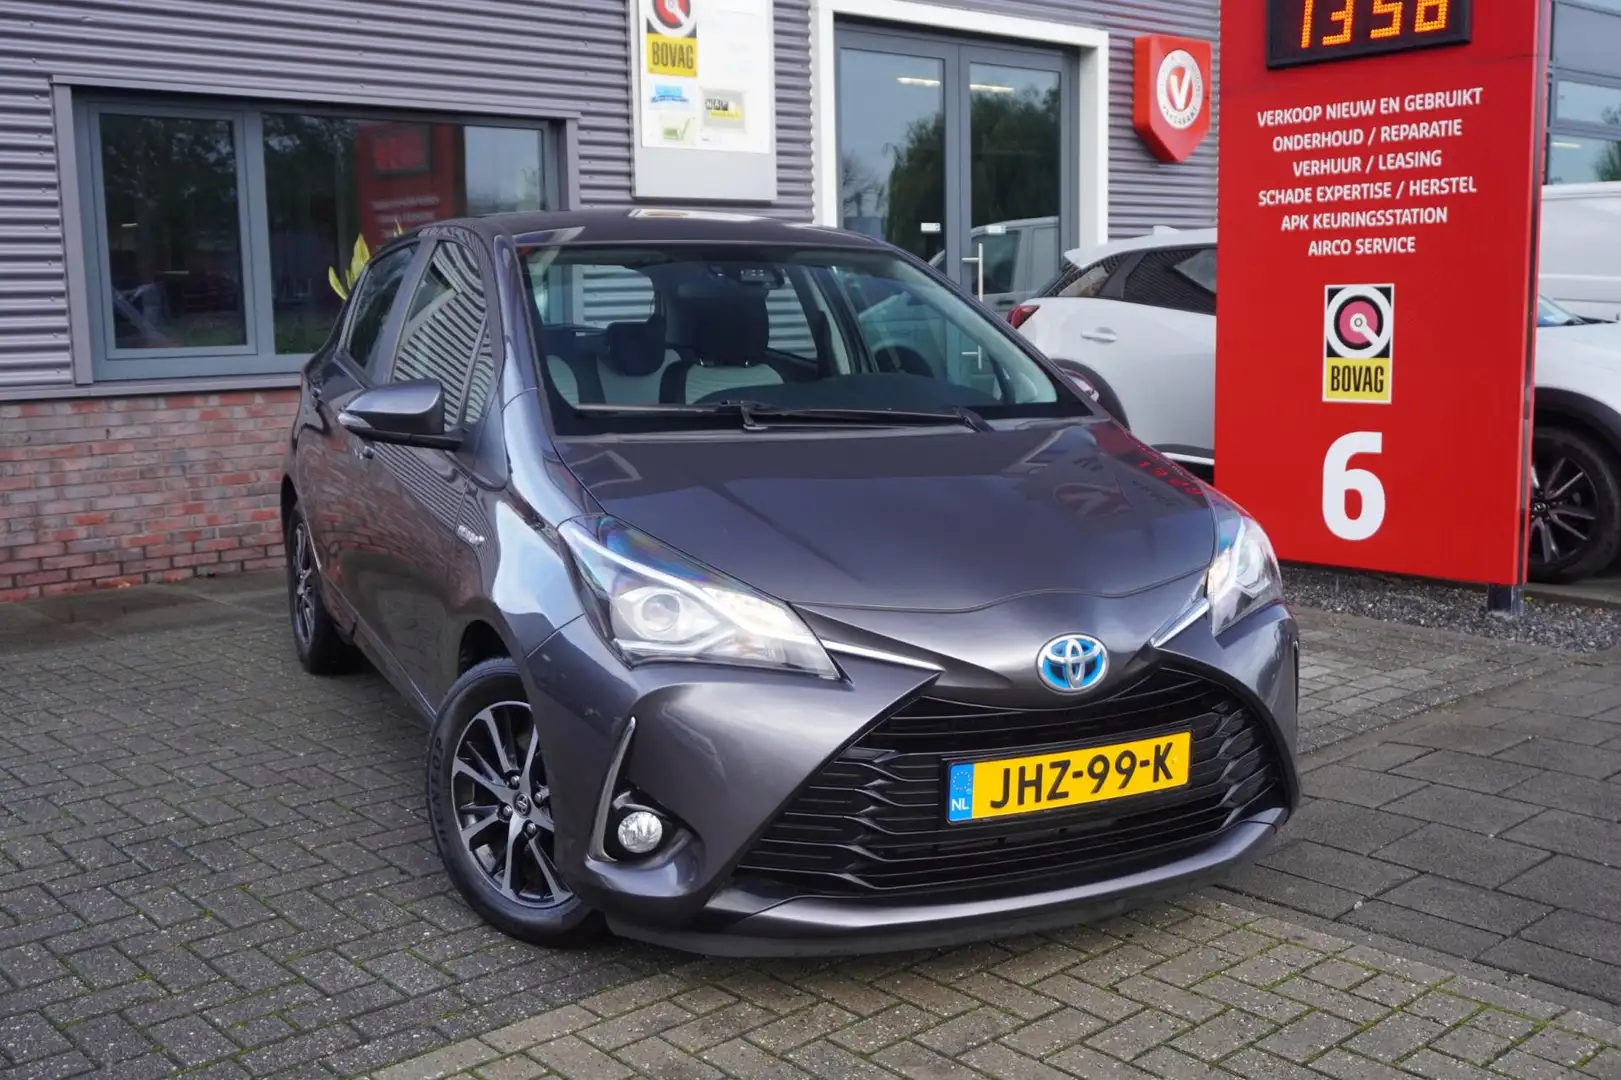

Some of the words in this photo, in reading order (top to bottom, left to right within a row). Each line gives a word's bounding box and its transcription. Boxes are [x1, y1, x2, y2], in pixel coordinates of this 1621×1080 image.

[652, 41, 694, 69] BOVAG
[1257, 105, 1322, 127] VERKOOP
[1326, 98, 1376, 120] NIEUW
[1380, 96, 1400, 115] EN
[1404, 87, 1483, 112] GEBRUIKT
[1273, 128, 1364, 152] ONDERHOUD
[1368, 127, 1377, 147] /
[1381, 119, 1463, 143] REPARATIE
[1293, 156, 1362, 177] VERHUUR
[1366, 155, 1375, 174] /
[1379, 149, 1442, 171] LEASING
[1258, 187, 1313, 207] SCHADE
[1317, 182, 1392, 202] EXPERTISE
[1396, 181, 1405, 200] /
[1409, 176, 1477, 196] HERSTEL
[1281, 214, 1309, 231] APK
[1313, 206, 1448, 229] KEURINGSSTATION
[1308, 239, 1352, 257] AIRCO
[1355, 235, 1416, 254] SERVICE
[1330, 365, 1384, 393] BOVAG
[1322, 431, 1386, 541] 6
[990, 742, 1174, 809] JHZ-99-K
[951, 798, 969, 811] NL
